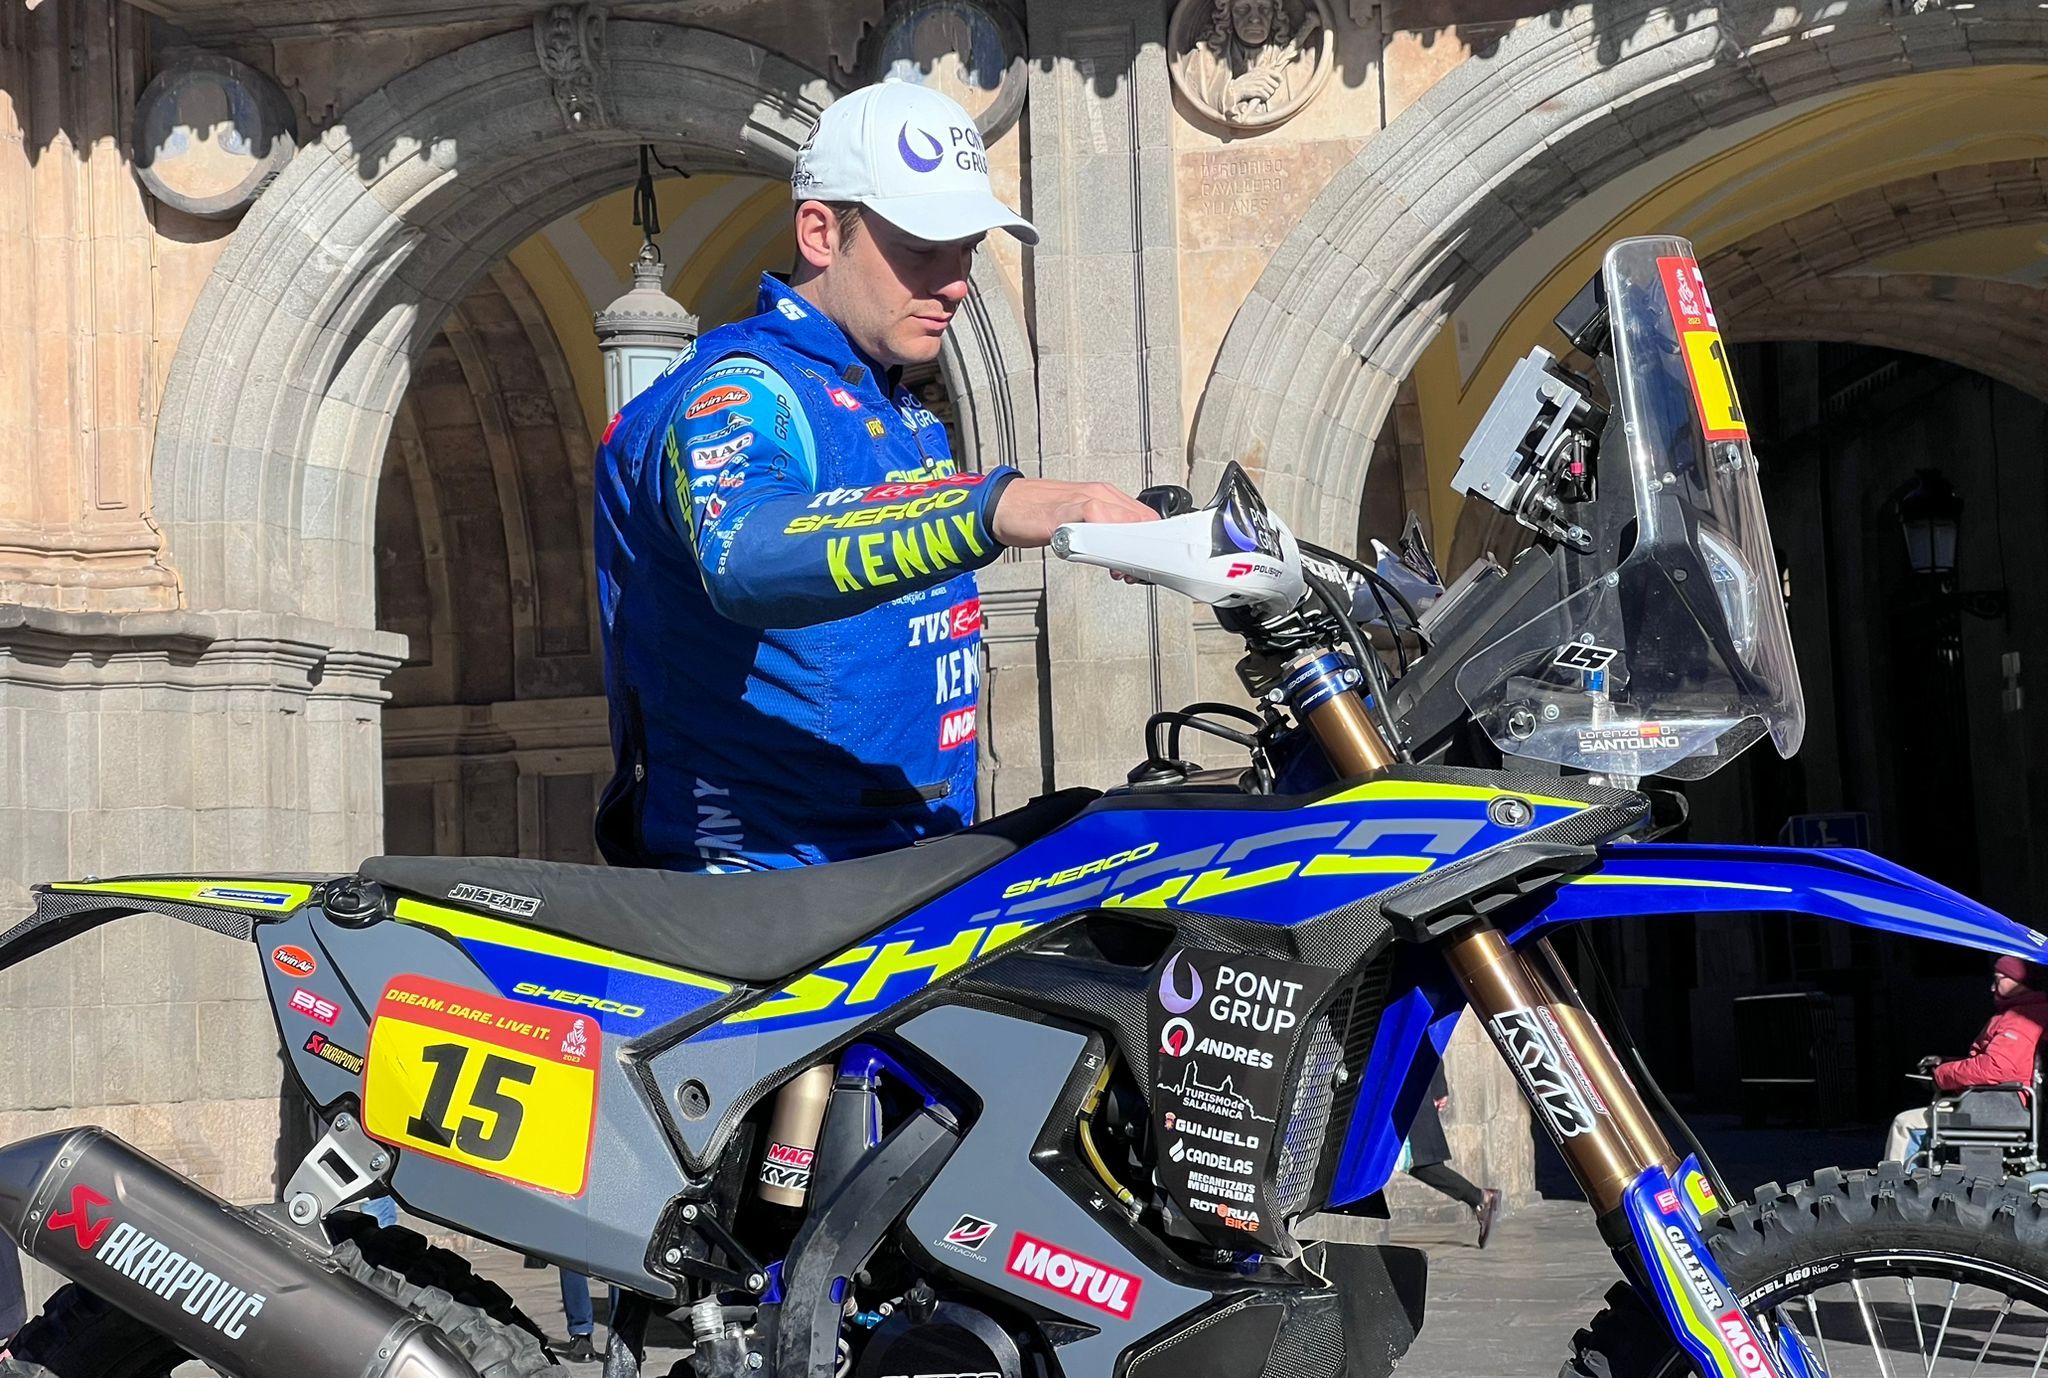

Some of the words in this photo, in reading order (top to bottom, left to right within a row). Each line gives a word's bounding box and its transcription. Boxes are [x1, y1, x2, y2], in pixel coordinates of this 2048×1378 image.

[1219, 158, 1283, 177] RODRIGO
[1202, 178, 1281, 197] CAVALLERO
[690, 367, 762, 391] MICHELIN
[690, 394, 721, 416] Twin
[721, 390, 748, 404] Air
[774, 394, 792, 441] GRUP
[783, 488, 970, 534] SHERCO
[807, 487, 873, 509] TVS
[826, 511, 984, 593] KENNY
[909, 610, 950, 647] TVS
[1578, 729, 1640, 739] Lorenzo
[1580, 736, 1680, 751] SANTOLINO
[1002, 842, 1159, 899] SHERCO
[274, 950, 298, 966] Twin
[297, 959, 315, 972] Air
[512, 982, 645, 1019] SHERCO
[1215, 965, 1303, 1008] PONT
[293, 990, 337, 1018] BS
[384, 988, 444, 1012] DREAM.
[447, 1003, 493, 1025] DARE.
[496, 1016, 531, 1037] LIVE
[532, 1025, 551, 1040] IT.
[1209, 994, 1296, 1035] GRUP
[1195, 1037, 1274, 1069] ANDRÉS
[1494, 1007, 1596, 1137] KYB
[406, 1043, 536, 1162] 15
[1182, 1097, 1243, 1121] SALAMANCA
[1175, 1118, 1260, 1149] GUIJUELO
[769, 1144, 814, 1165] MAC
[1185, 1148, 1254, 1175] CANDELAS
[1187, 1179, 1254, 1203] MUNTADA
[1189, 1197, 1260, 1223] ROTORUA
[1225, 1217, 1260, 1232] BIKE
[933, 1240, 988, 1263] UNIRACING
[1012, 1241, 1131, 1312] MOTUL
[1666, 1225, 1724, 1311] GALFER
[1740, 1280, 1784, 1309] EXCEL
[1785, 1267, 1811, 1285] A60
[1721, 1319, 1774, 1378] MOT
